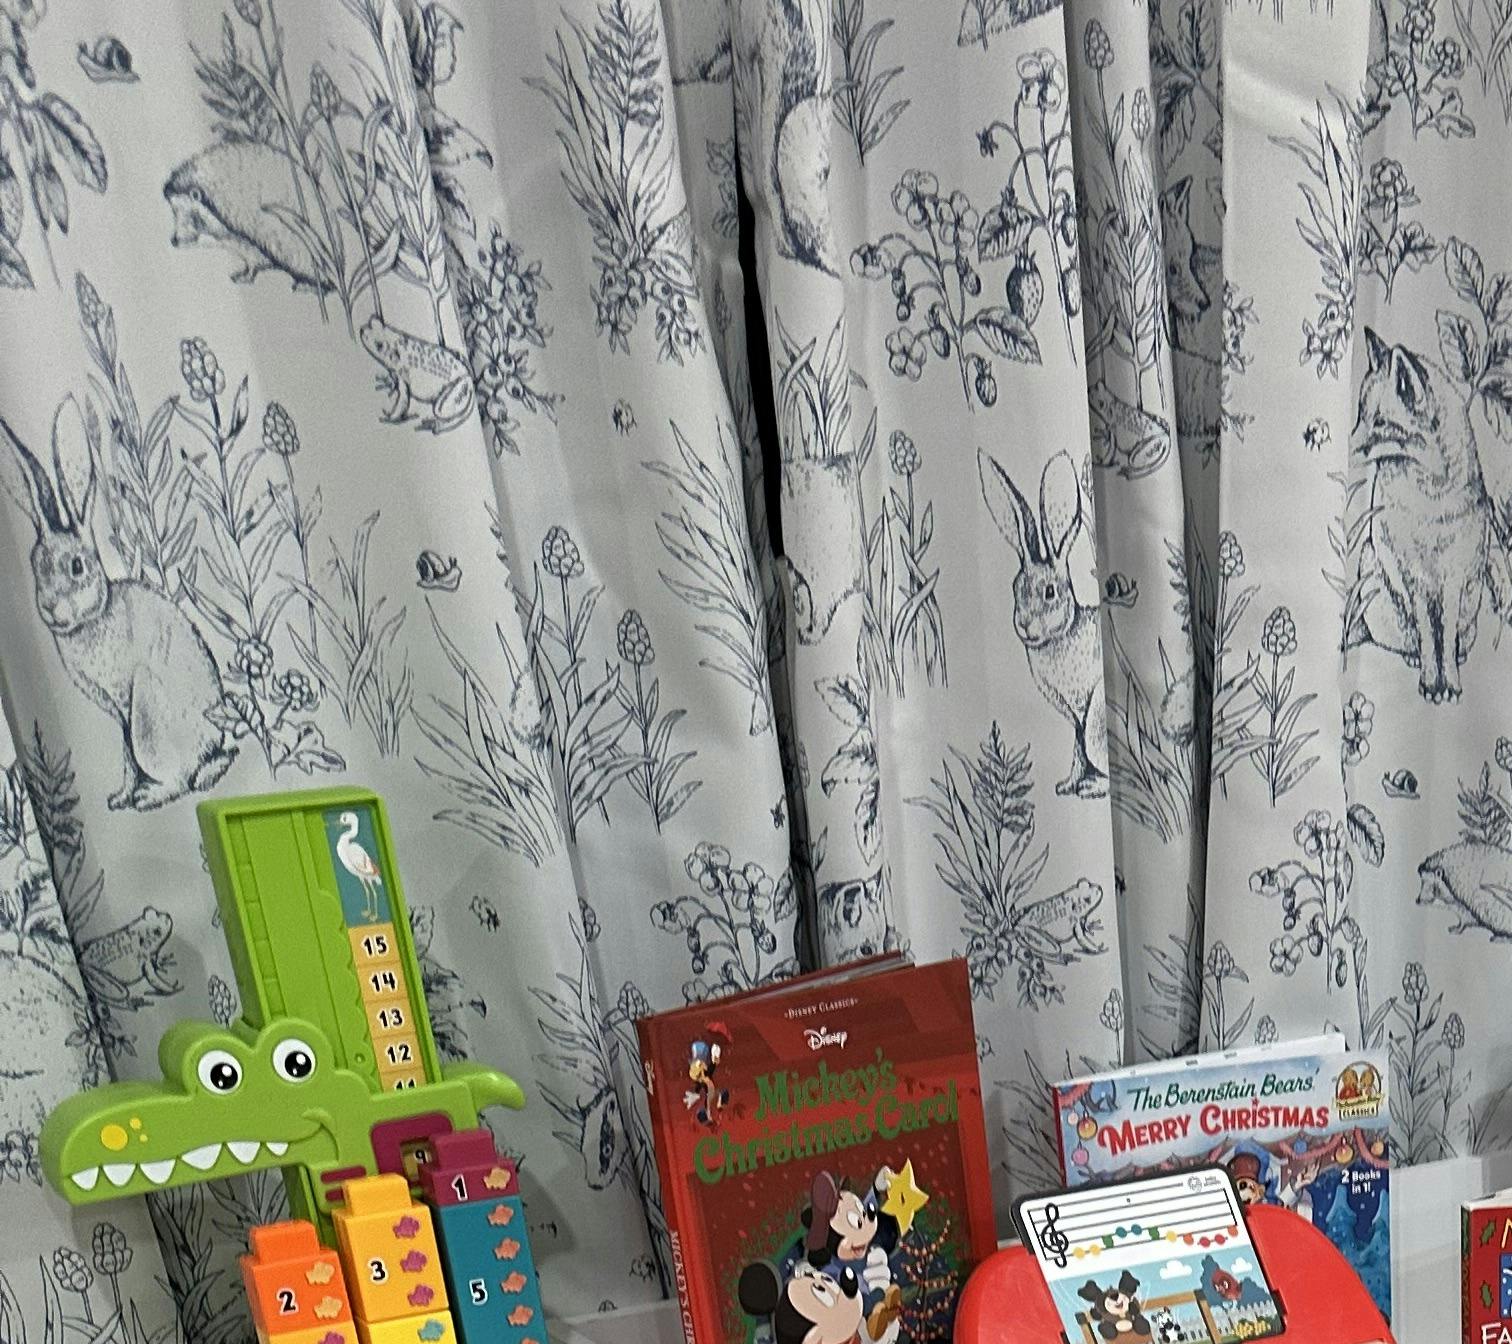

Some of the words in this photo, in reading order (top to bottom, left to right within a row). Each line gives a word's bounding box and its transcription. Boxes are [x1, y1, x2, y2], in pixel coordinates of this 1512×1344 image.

[362, 935, 388, 957] 15
[371, 971, 396, 993] 14
[378, 1008, 403, 1028] 13
[387, 1044, 412, 1065] 12
[756, 1048, 896, 1120] Mickey's
[1127, 1086, 1162, 1111] The
[1164, 1077, 1257, 1106] Berenstain
[1260, 1067, 1320, 1097] Bears'
[693, 1110, 873, 1184] Christmas
[875, 1080, 959, 1140] Carol
[1097, 1115, 1191, 1156] MERRY
[1199, 1101, 1329, 1137] CHRISTMAS
[453, 1175, 466, 1199] 1
[1341, 1169, 1350, 1184] 2
[370, 1259, 387, 1281] 3
[278, 1291, 296, 1313] 2
[471, 1281, 486, 1302] 5
